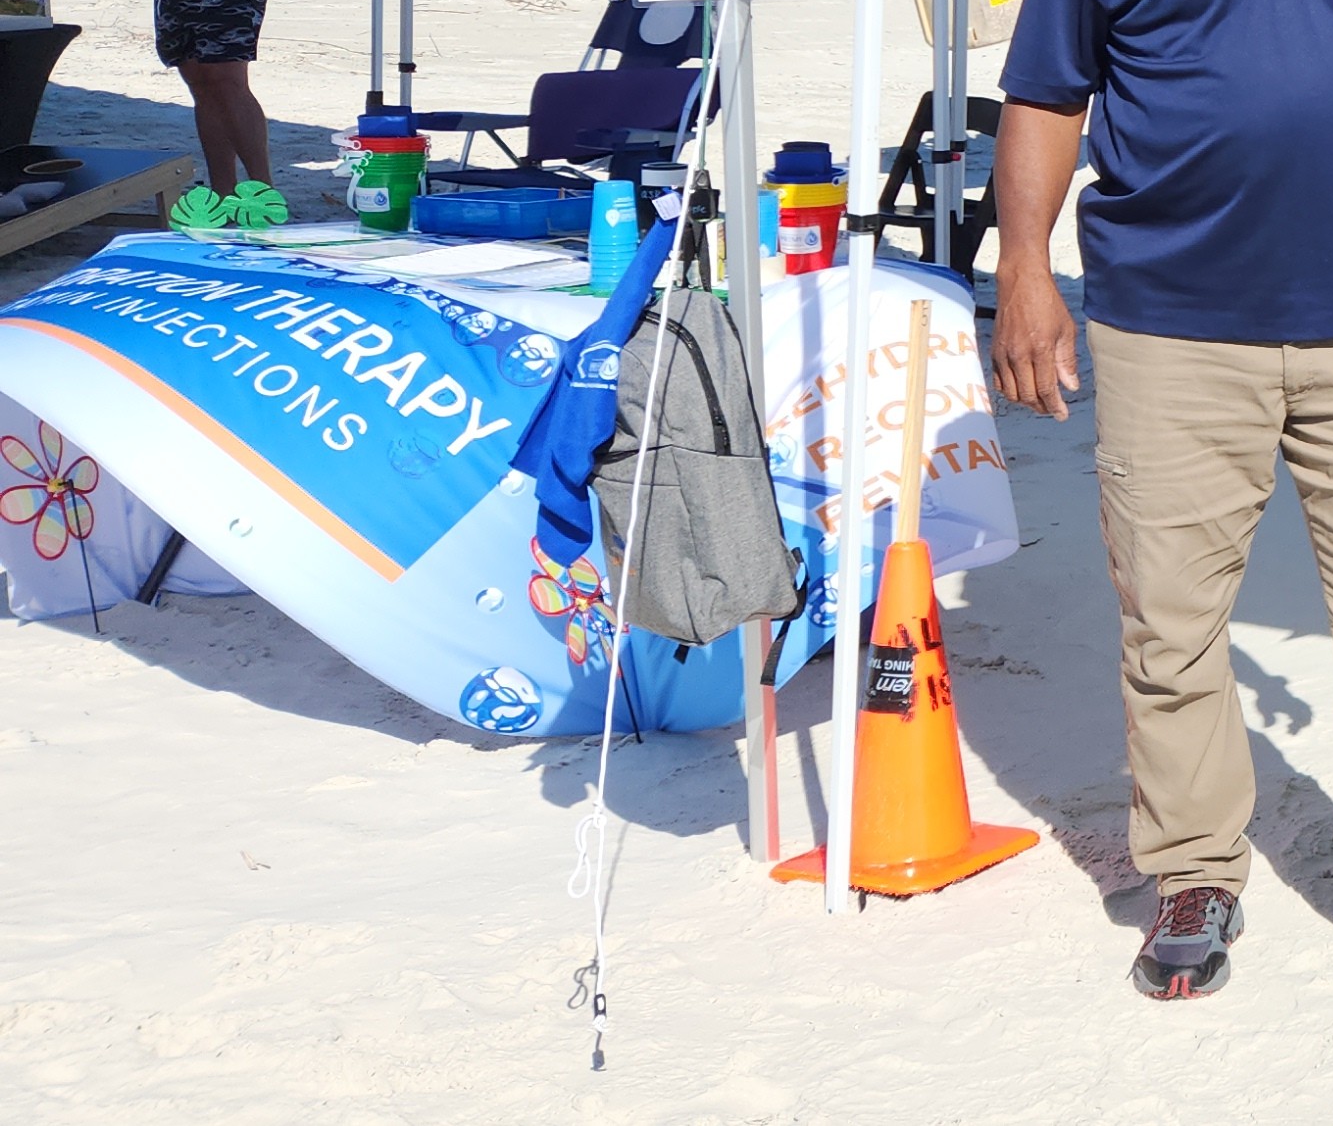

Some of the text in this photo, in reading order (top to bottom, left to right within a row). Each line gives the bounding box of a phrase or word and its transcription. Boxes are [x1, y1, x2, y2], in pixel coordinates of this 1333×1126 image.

[92, 296, 367, 451] INJECTIONS
[233, 288, 512, 456] THERAPY
[806, 382, 994, 473] RCOVE
